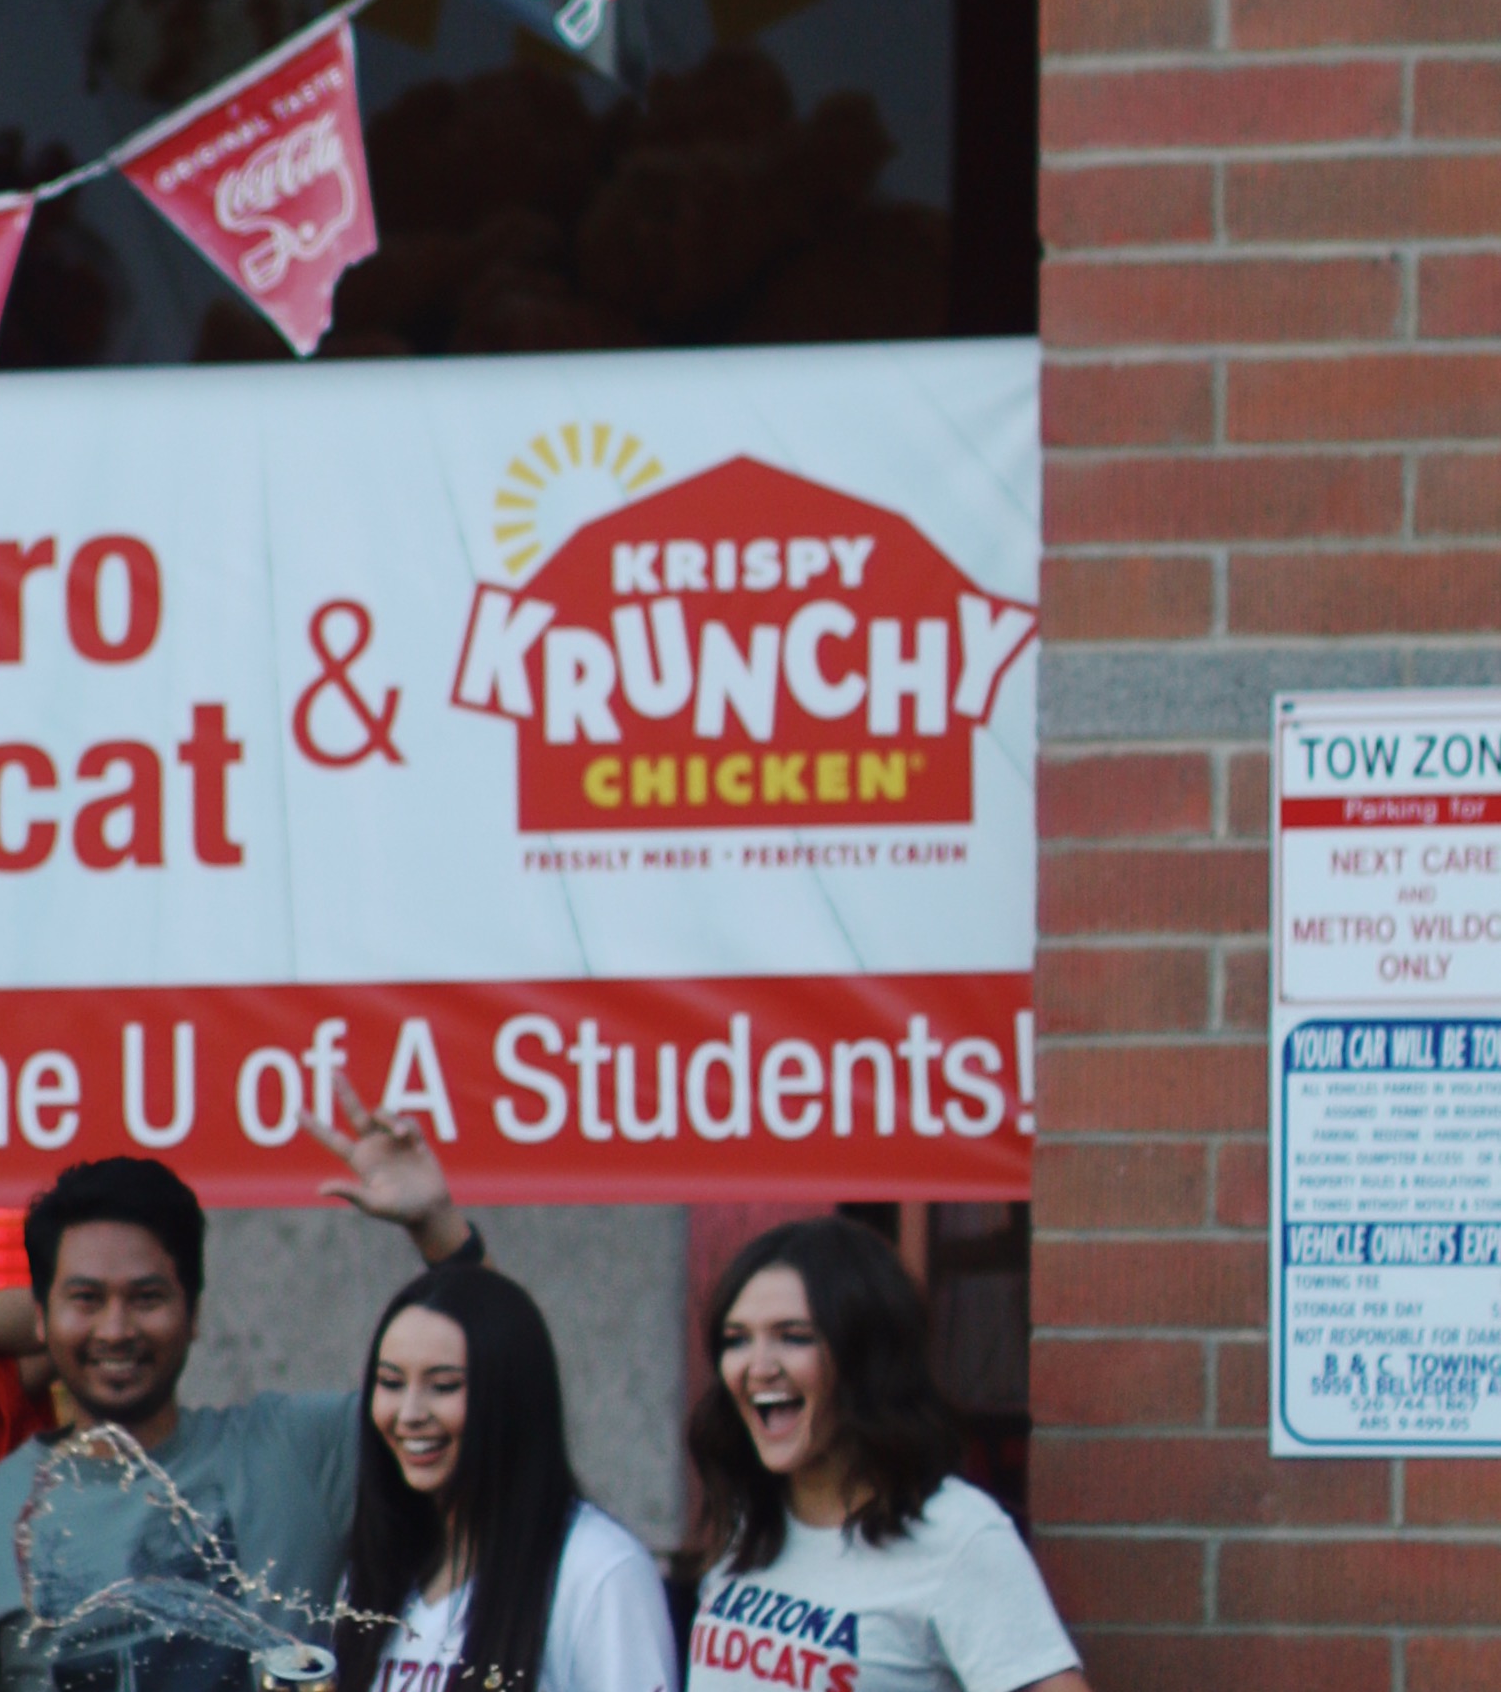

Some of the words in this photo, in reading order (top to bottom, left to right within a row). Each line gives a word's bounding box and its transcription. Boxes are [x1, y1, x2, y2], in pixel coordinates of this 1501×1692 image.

[154, 113, 271, 195] ORIGINAL
[271, 65, 345, 119] TASTE
[612, 535, 876, 596] KRISPY
[292, 598, 407, 770] &
[455, 588, 1040, 746] KRUNCHY
[1299, 735, 1400, 781] TOW
[1344, 797, 1440, 826] Parking
[1450, 796, 1488, 819] for
[524, 849, 631, 873] FRESHLY
[642, 848, 712, 871] MADE
[742, 843, 879, 868] PERFECTLY
[888, 841, 968, 865] CAJUN
[1330, 847, 1407, 876] NEXT
[1420, 844, 1500, 875] CARE
[1292, 915, 1399, 944] METRO
[1377, 953, 1453, 983] ONLY
[1293, 1025, 1344, 1069] YOUR
[1348, 1025, 1388, 1069] CAR
[1391, 1025, 1437, 1069] WILL
[1440, 1025, 1468, 1069] BE
[1471, 1025, 1501, 1069] TO
[121, 1020, 196, 1149] U
[235, 1017, 347, 1148] of
[379, 1016, 459, 1144] A
[492, 1008, 1037, 1145] Students!
[1289, 1225, 1367, 1263] VEHICLE
[1294, 1302, 1357, 1318] STORAGE
[1362, 1302, 1389, 1318] PER
[1294, 1327, 1325, 1346] NOT
[1330, 1327, 1425, 1345] RESPONSIBLE
[1376, 1353, 1393, 1376] C
[707, 1580, 860, 1658] ARIZONA
